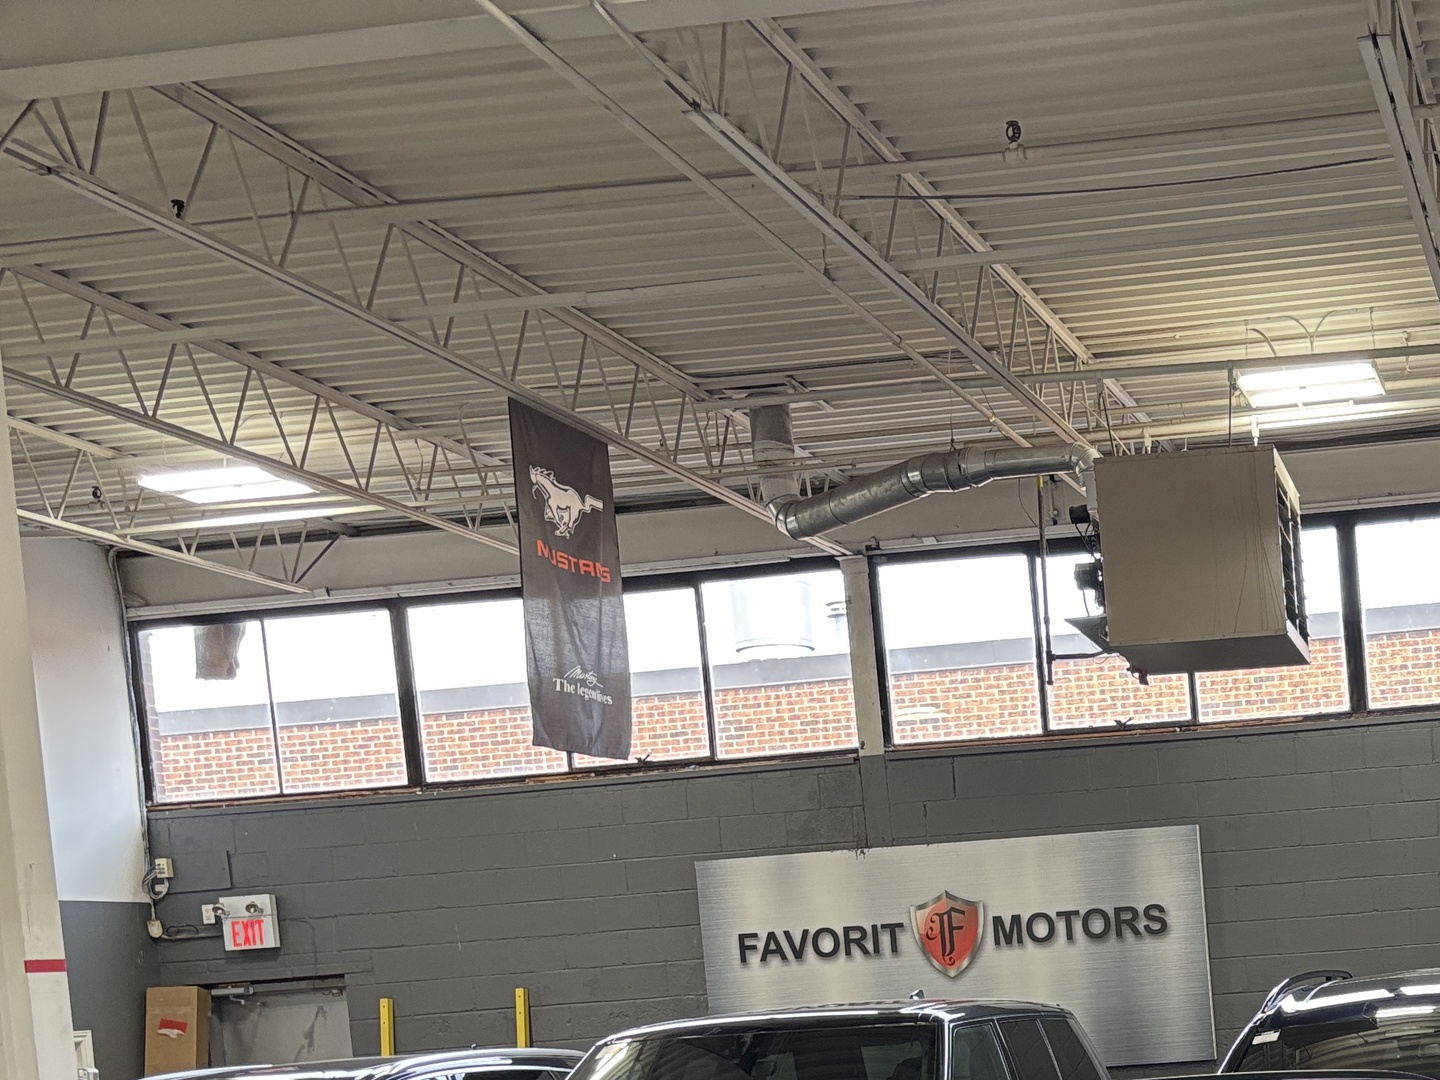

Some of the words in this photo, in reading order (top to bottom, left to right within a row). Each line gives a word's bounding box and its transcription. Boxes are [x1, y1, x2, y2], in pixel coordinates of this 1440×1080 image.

[552, 678, 576, 694] The
[231, 918, 265, 948] EXIT
[738, 922, 905, 964] FAVORIT
[992, 903, 1168, 946] MOTORS
